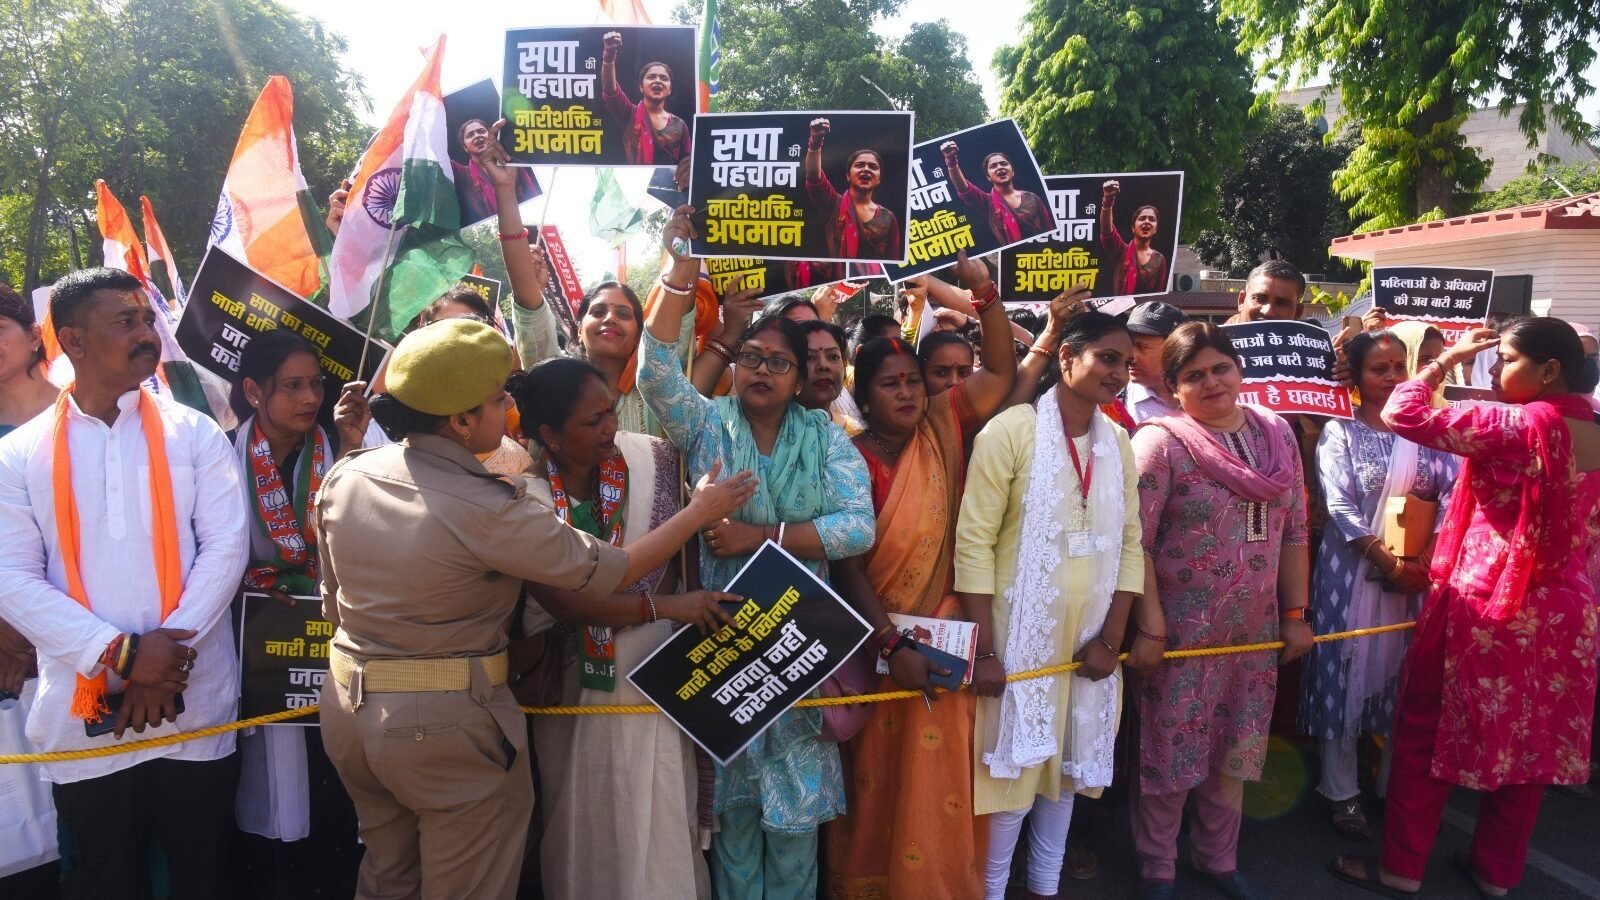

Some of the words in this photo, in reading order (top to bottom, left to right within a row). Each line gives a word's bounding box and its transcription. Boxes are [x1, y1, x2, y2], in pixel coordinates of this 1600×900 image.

[517, 41, 579, 73] सपा
[585, 57, 596, 69] की
[517, 74, 596, 99] पहचान
[514, 105, 592, 128] नारीशक्ति
[514, 129, 603, 154] अपमान
[711, 128, 783, 161] सपा
[788, 144, 801, 157] की
[711, 162, 800, 187] पहचान
[932, 167, 944, 179] की
[707, 194, 793, 219] नारीशक्ति
[911, 180, 952, 211] चान
[1048, 189, 1080, 218] पा
[1085, 204, 1096, 215] की
[706, 220, 805, 246] अपमान
[1016, 248, 1090, 270] नारीशक्ति
[1380, 276, 1427, 289] महिलाओं
[1430, 277, 1441, 290] के
[1444, 278, 1487, 292] अधिकारों
[211, 290, 247, 320] नारी
[1394, 294, 1408, 306] की
[1412, 296, 1428, 307] जब
[1431, 296, 1451, 308] बारी
[1453, 297, 1473, 310] आई
[249, 292, 281, 319] सपा
[280, 311, 303, 332] का
[302, 322, 332, 349] हाथ
[1231, 333, 1264, 349] लाओं
[1268, 332, 1282, 346] के
[1287, 334, 1330, 352] अधिकारों
[210, 342, 242, 373] करे
[1250, 355, 1273, 367] जब
[1277, 352, 1301, 366] बारी
[1305, 356, 1326, 370] आई
[1265, 385, 1280, 405] है
[305, 620, 332, 636] सप
[686, 637, 718, 664] सपा
[733, 598, 761, 630] हाथ
[265, 638, 305, 657] नारी
[676, 668, 711, 701] नारी
[706, 646, 740, 676] शक्ति
[734, 635, 754, 652] के
[747, 585, 800, 642] खिलाफ
[711, 657, 771, 705] जनता
[762, 618, 807, 664] नहीं
[729, 673, 788, 725] करेगी
[780, 639, 828, 682] माफ
